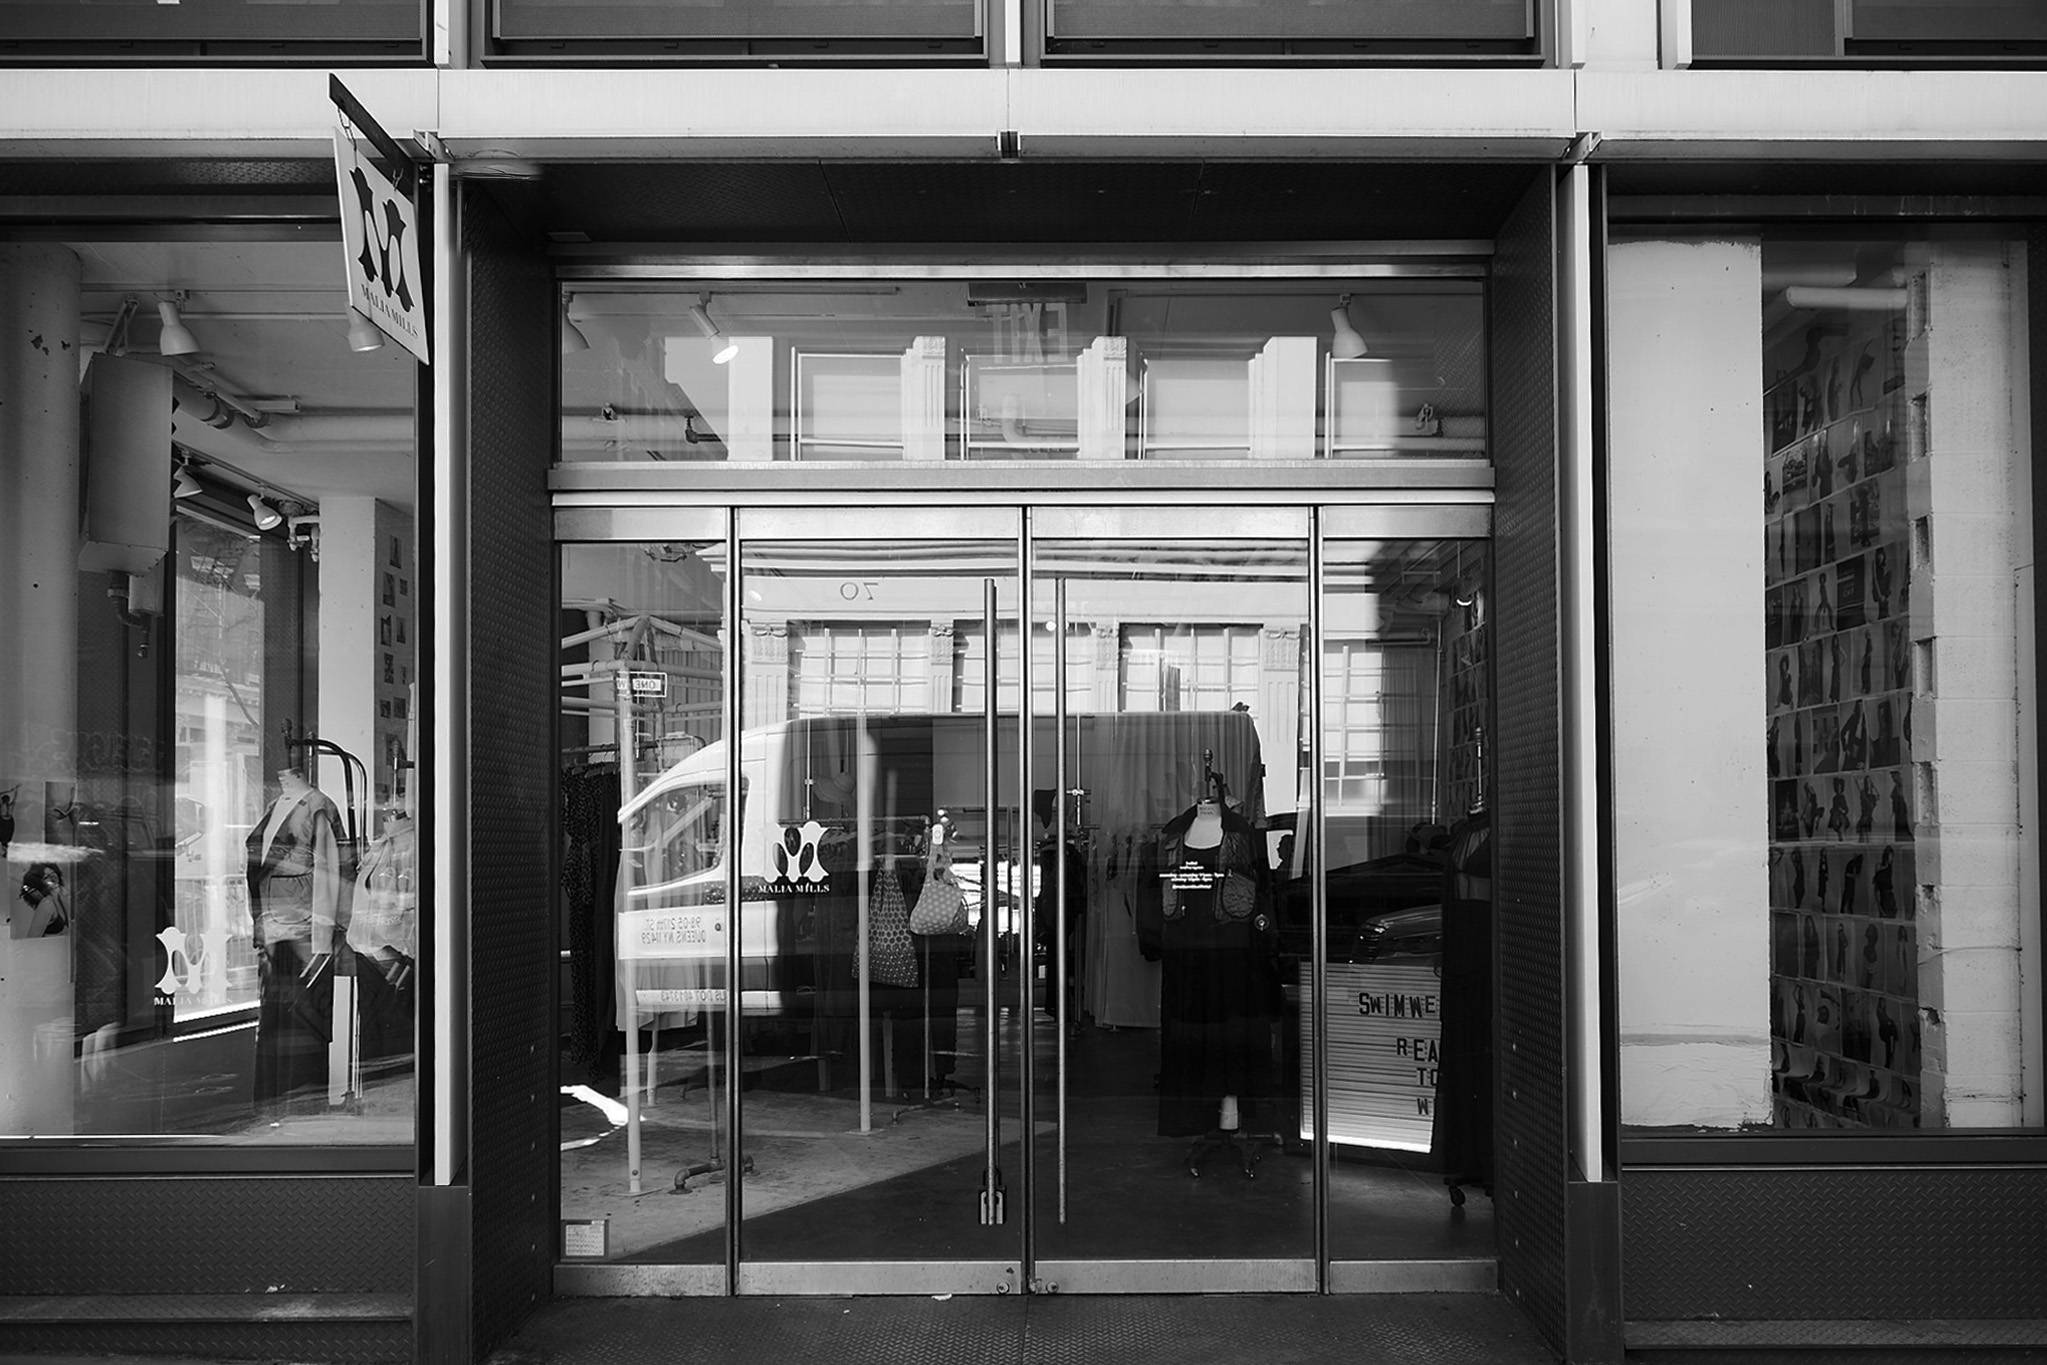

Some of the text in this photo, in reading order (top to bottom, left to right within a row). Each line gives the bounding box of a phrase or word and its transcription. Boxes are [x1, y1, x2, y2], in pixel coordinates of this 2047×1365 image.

[361, 284, 418, 336] MALIA MILLS
[758, 882, 831, 894] MALIA MILLS
[1396, 1038, 1438, 1062] REA
